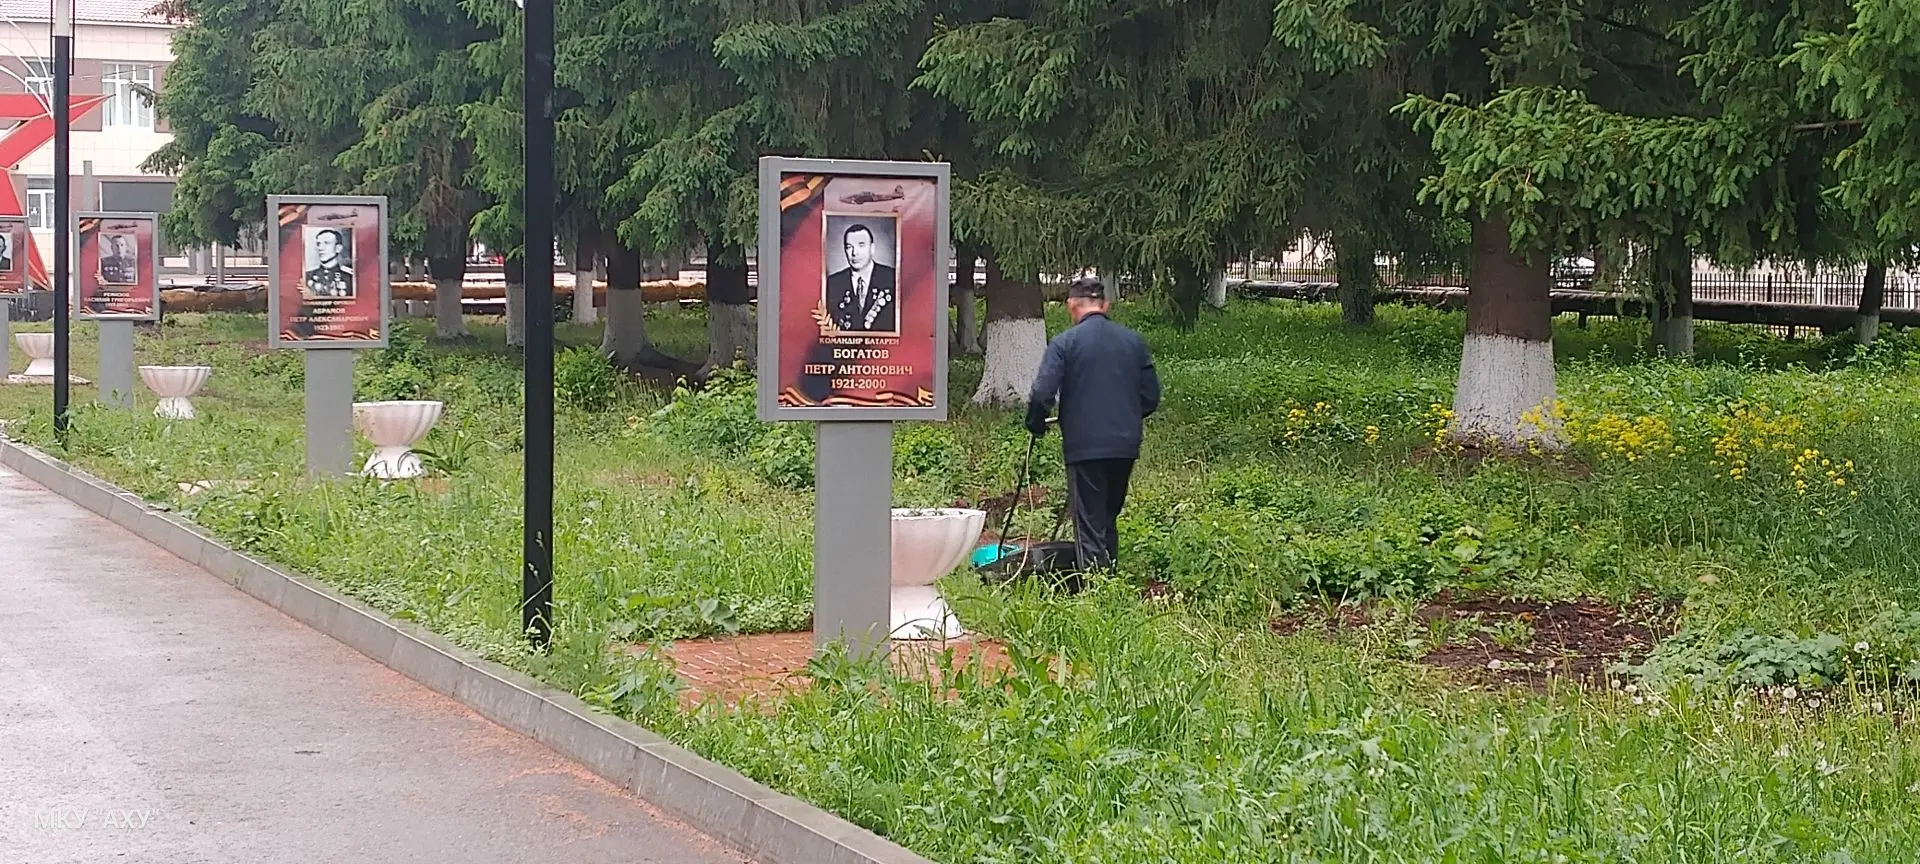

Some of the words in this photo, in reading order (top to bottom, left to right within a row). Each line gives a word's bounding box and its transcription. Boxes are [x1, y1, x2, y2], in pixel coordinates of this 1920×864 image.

[818, 337, 863, 345] КОМАНДИР
[833, 348, 890, 359] БОГАТОВ
[804, 364, 836, 375] ПЕТР
[838, 364, 913, 375] АНТОНОВИЧ
[831, 378, 887, 389] 1921-2000
